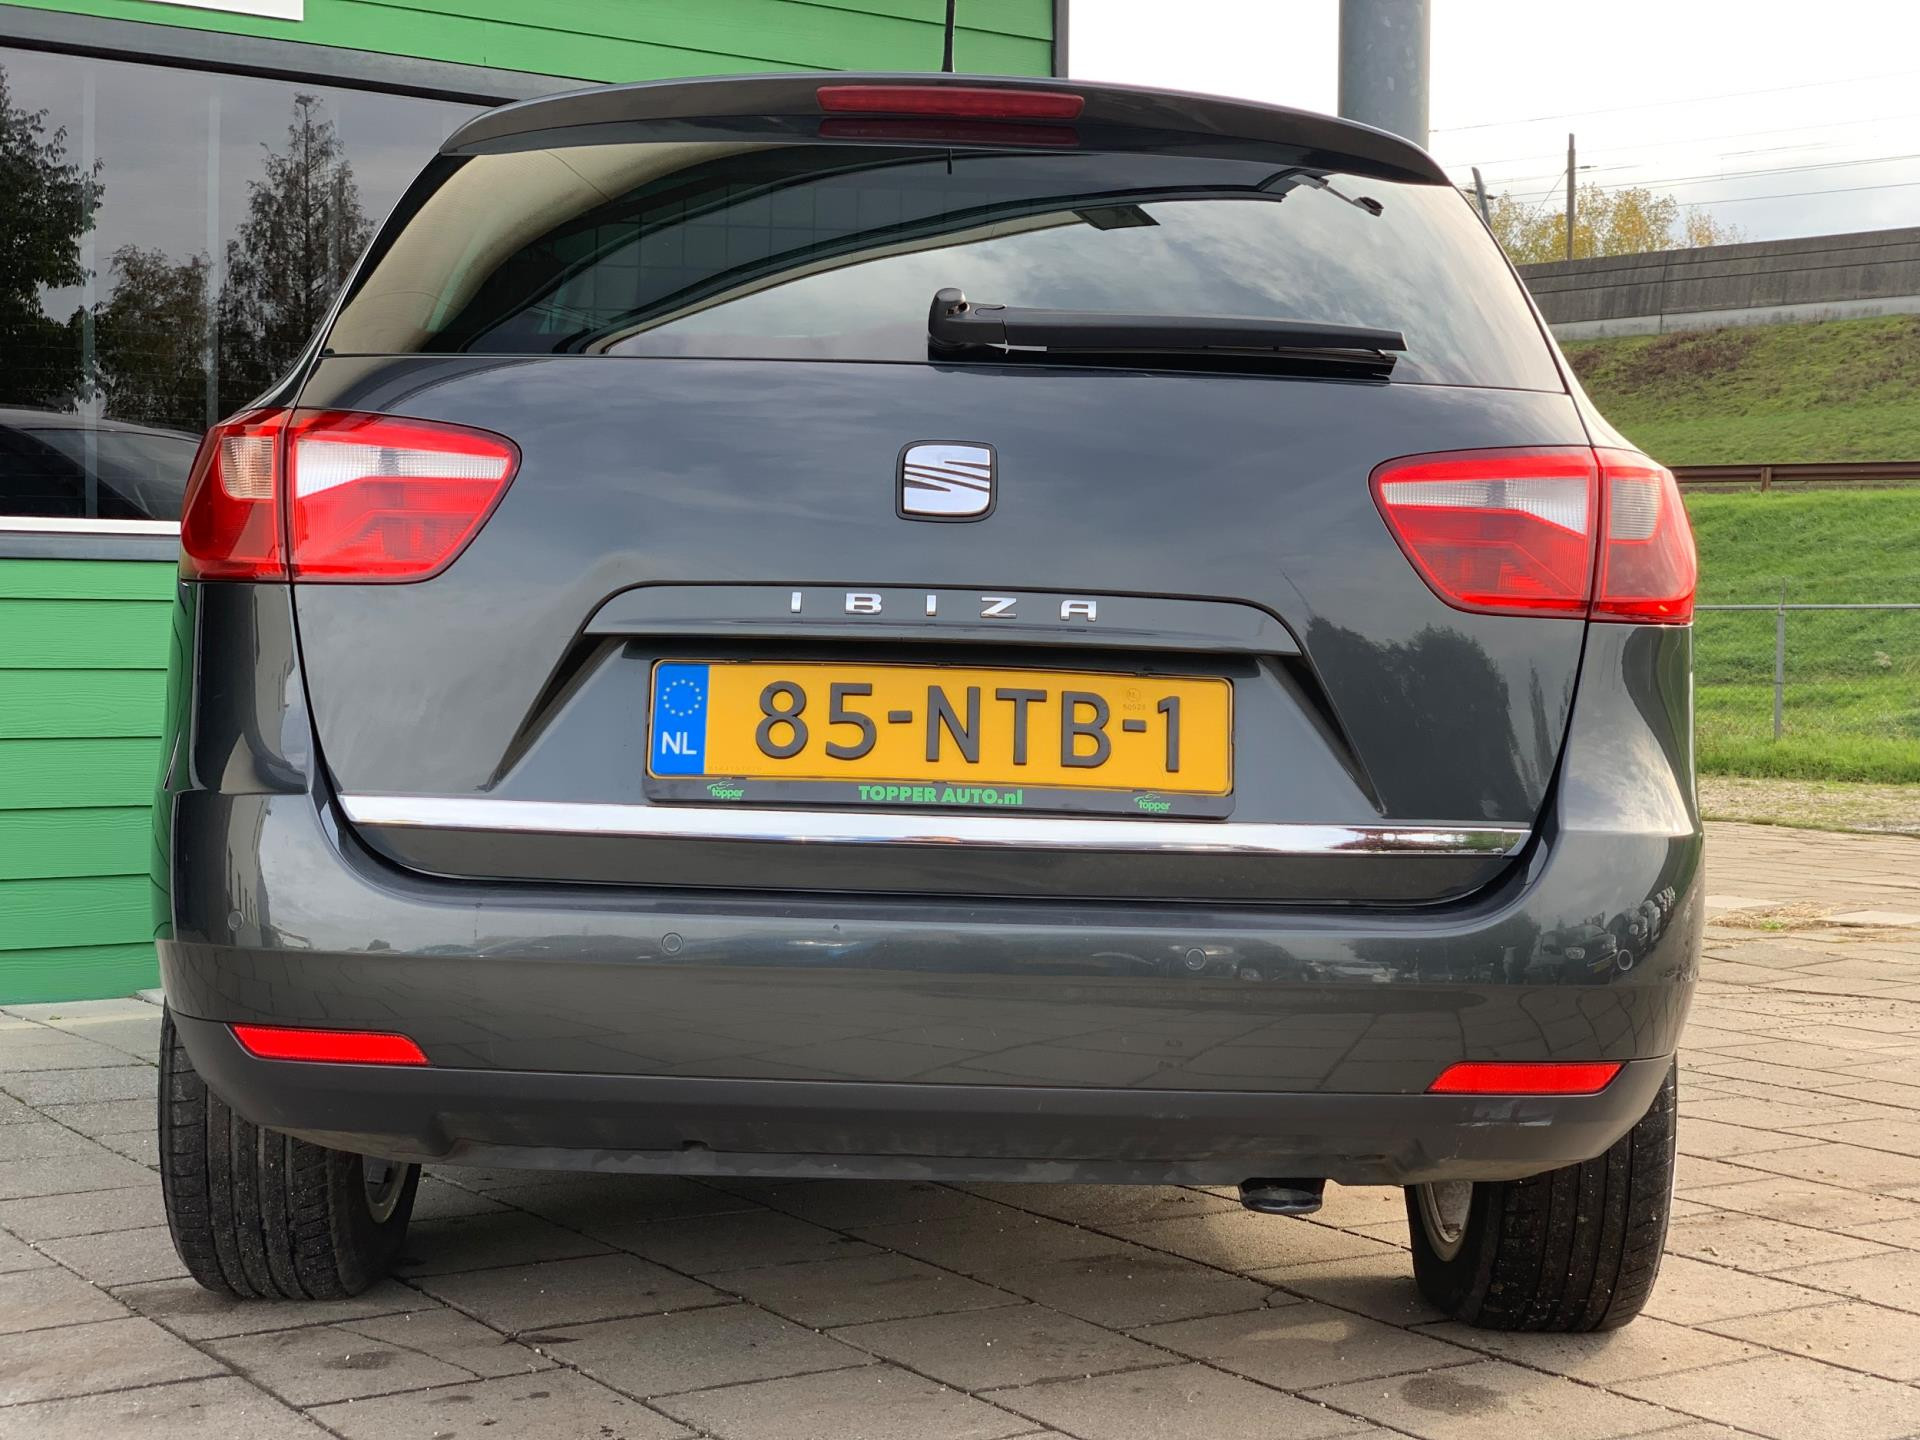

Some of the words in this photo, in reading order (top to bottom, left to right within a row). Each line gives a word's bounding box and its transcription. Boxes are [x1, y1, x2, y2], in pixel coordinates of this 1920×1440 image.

[790, 591, 1098, 622] IBIZA
[754, 680, 1182, 772] 85-NTB-1
[661, 731, 697, 755] NL
[711, 787, 744, 799] topper
[858, 785, 937, 802] TOPPER
[941, 788, 1023, 805] AUTO.nl
